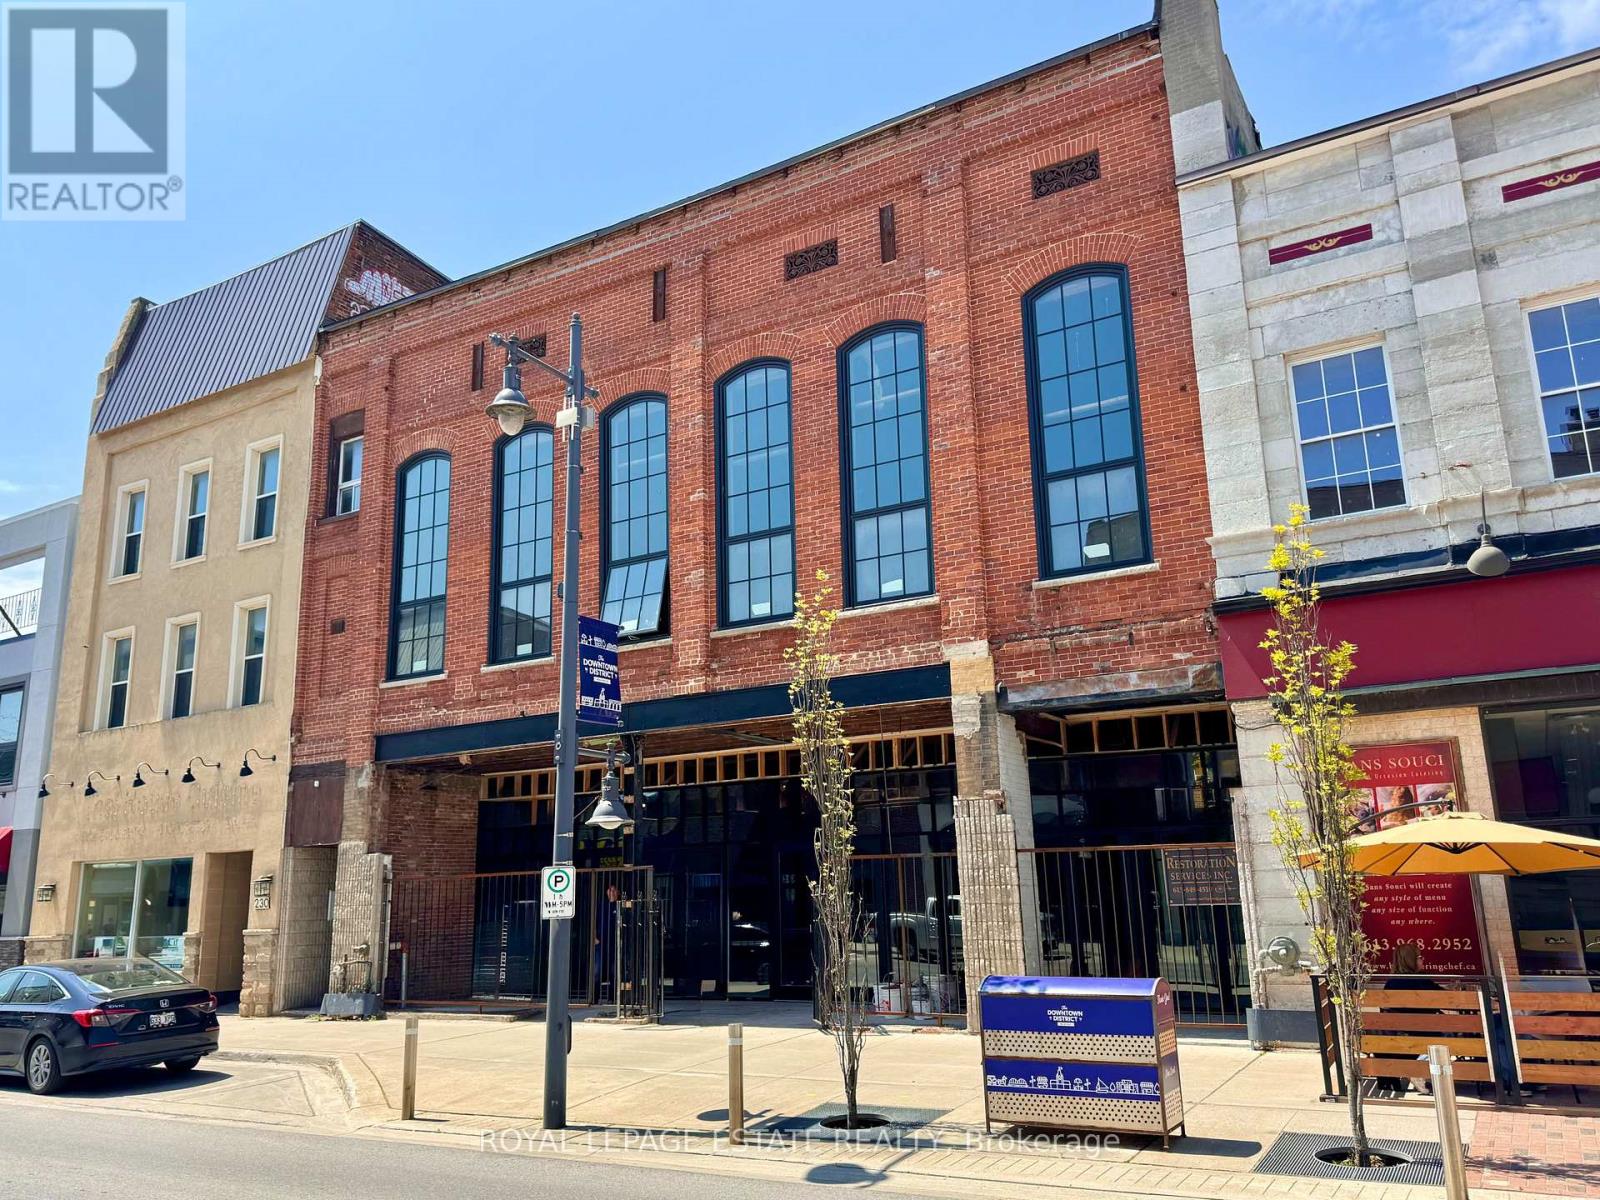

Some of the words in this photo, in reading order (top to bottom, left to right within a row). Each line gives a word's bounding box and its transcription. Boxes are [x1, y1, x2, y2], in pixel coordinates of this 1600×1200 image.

[583, 658, 618, 672] DOWNTOWN
[589, 667, 614, 679] DISTRICT
[1388, 754, 1444, 770] SOUCI
[1214, 870, 1233, 880] INC.
[554, 875, 564, 888] P
[255, 898, 269, 908] 230
[1391, 894, 1411, 903] style
[1418, 905, 1453, 913] function
[1408, 917, 1436, 925] where.
[1047, 1009, 1083, 1017] DOWNTOWN
